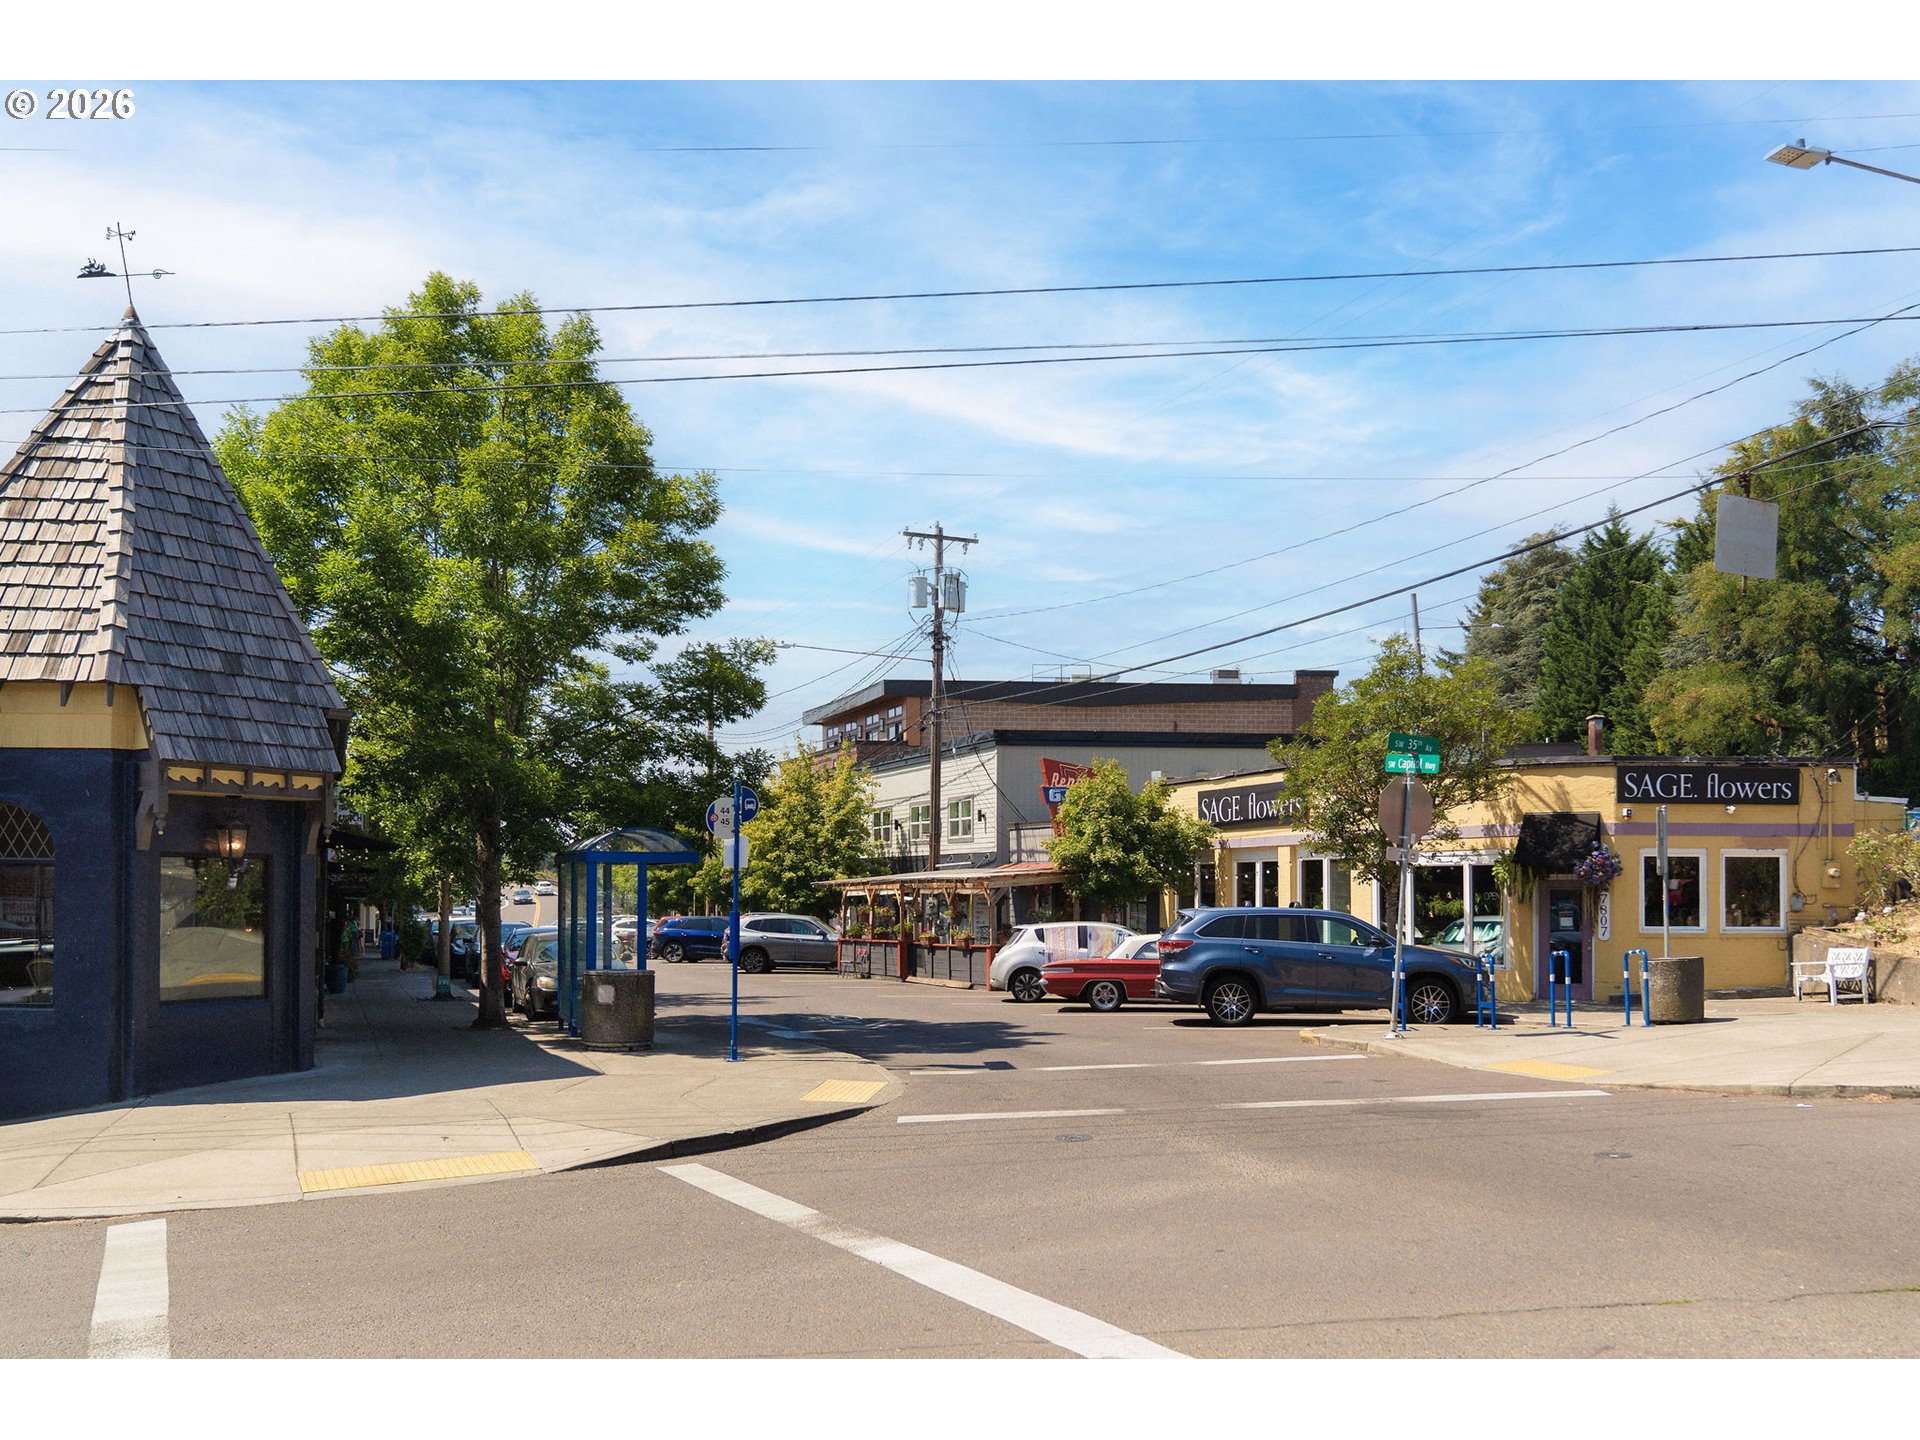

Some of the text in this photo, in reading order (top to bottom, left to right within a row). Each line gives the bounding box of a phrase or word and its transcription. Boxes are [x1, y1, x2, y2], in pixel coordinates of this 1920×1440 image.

[1398, 758, 1422, 771] Capitol
[1624, 772, 1792, 799] SAGE. flowers
[720, 818, 730, 826] 45
[1600, 894, 1608, 936] 7807
